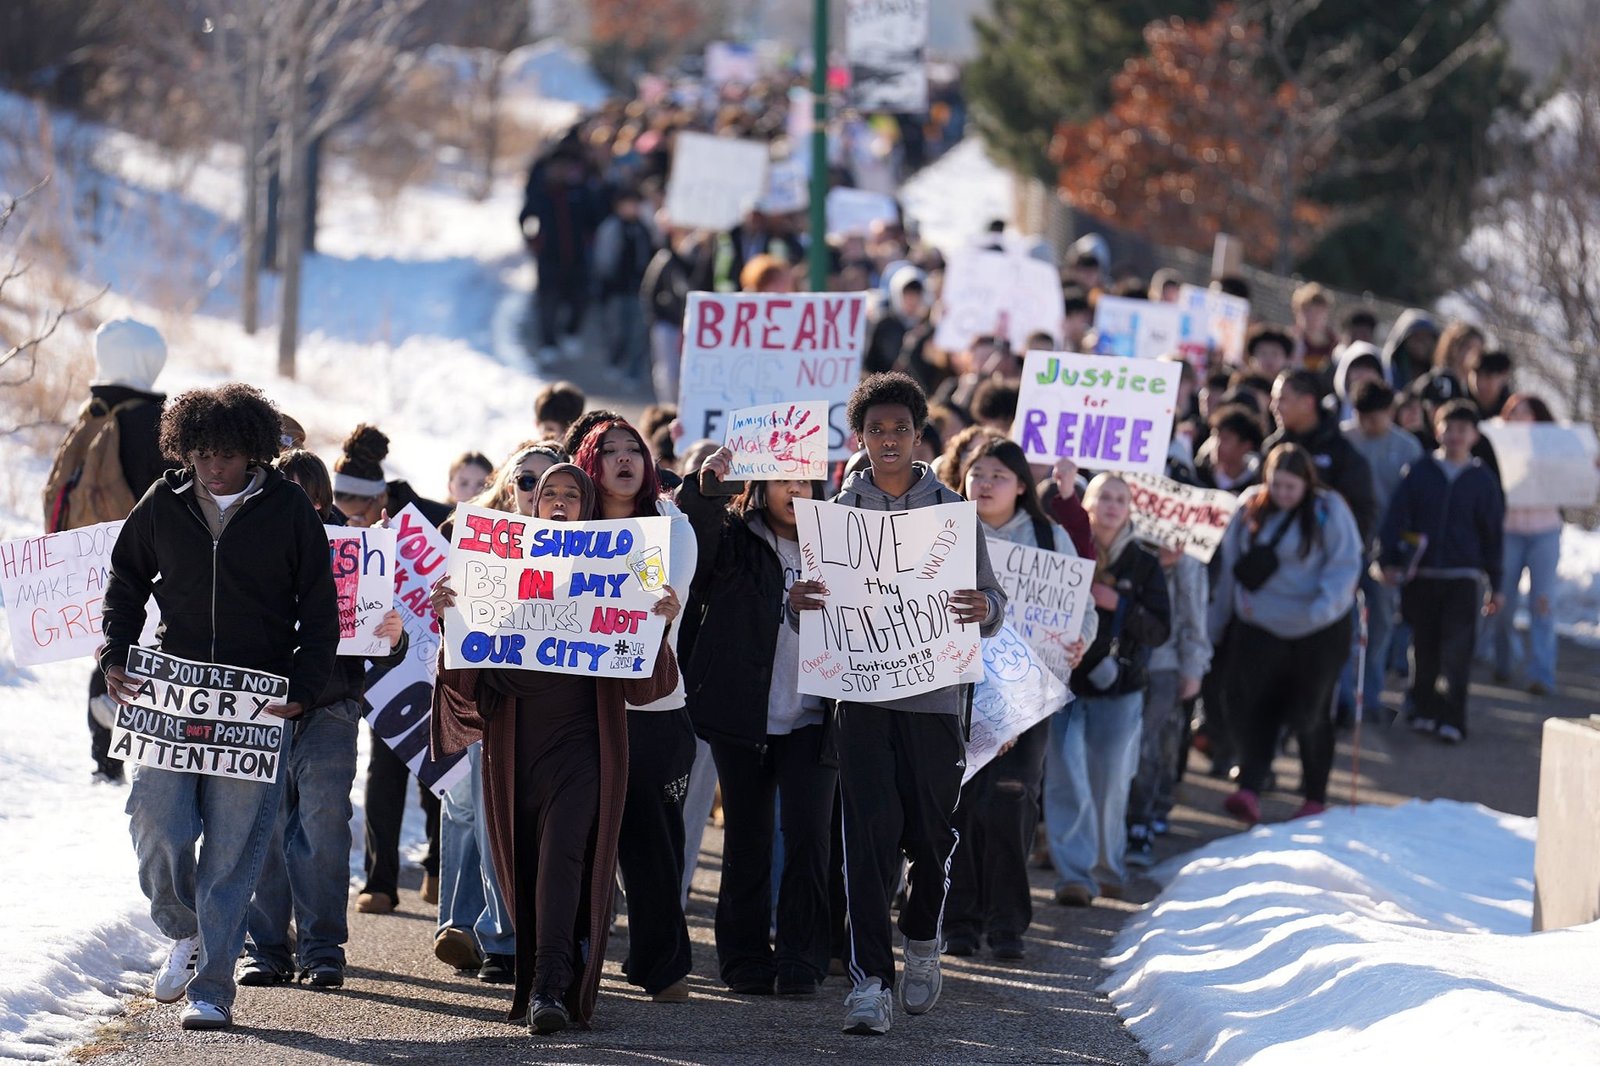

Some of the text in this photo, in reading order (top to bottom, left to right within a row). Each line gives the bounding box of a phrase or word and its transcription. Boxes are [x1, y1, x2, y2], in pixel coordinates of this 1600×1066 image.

[696, 299, 862, 351] BREAK!
[796, 357, 856, 388] NOT
[1035, 358, 1167, 395] Justice
[1082, 394, 1109, 408] for
[1021, 409, 1154, 463] RENEE
[0, 535, 65, 579] HATE
[397, 513, 447, 576] YOU
[457, 513, 634, 560] ICE SHOULD
[814, 505, 914, 574] LOVE
[464, 560, 507, 599] BE
[518, 568, 555, 601] IN
[568, 571, 630, 598] MY
[1006, 544, 1083, 588] CLAIMS
[16, 572, 82, 608] MAKE
[864, 577, 905, 614] thy
[1014, 576, 1076, 616] MAKING
[470, 600, 648, 635] DRINKS NOT
[821, 589, 965, 653] NEIGHBOR
[1024, 604, 1073, 629] GREAT
[460, 630, 610, 672] OUR CITY
[801, 651, 832, 674] Choose
[819, 662, 844, 681] Peace
[848, 648, 932, 672] Leviticus 19:18
[936, 640, 957, 664] Stop
[134, 650, 284, 694] IF YOU'RE NOT
[841, 660, 935, 693] STOP ICE!
[132, 679, 271, 721] ANGRY
[120, 704, 280, 749] YOU'RE NOT PAYING
[114, 732, 277, 779] ATTENTION
